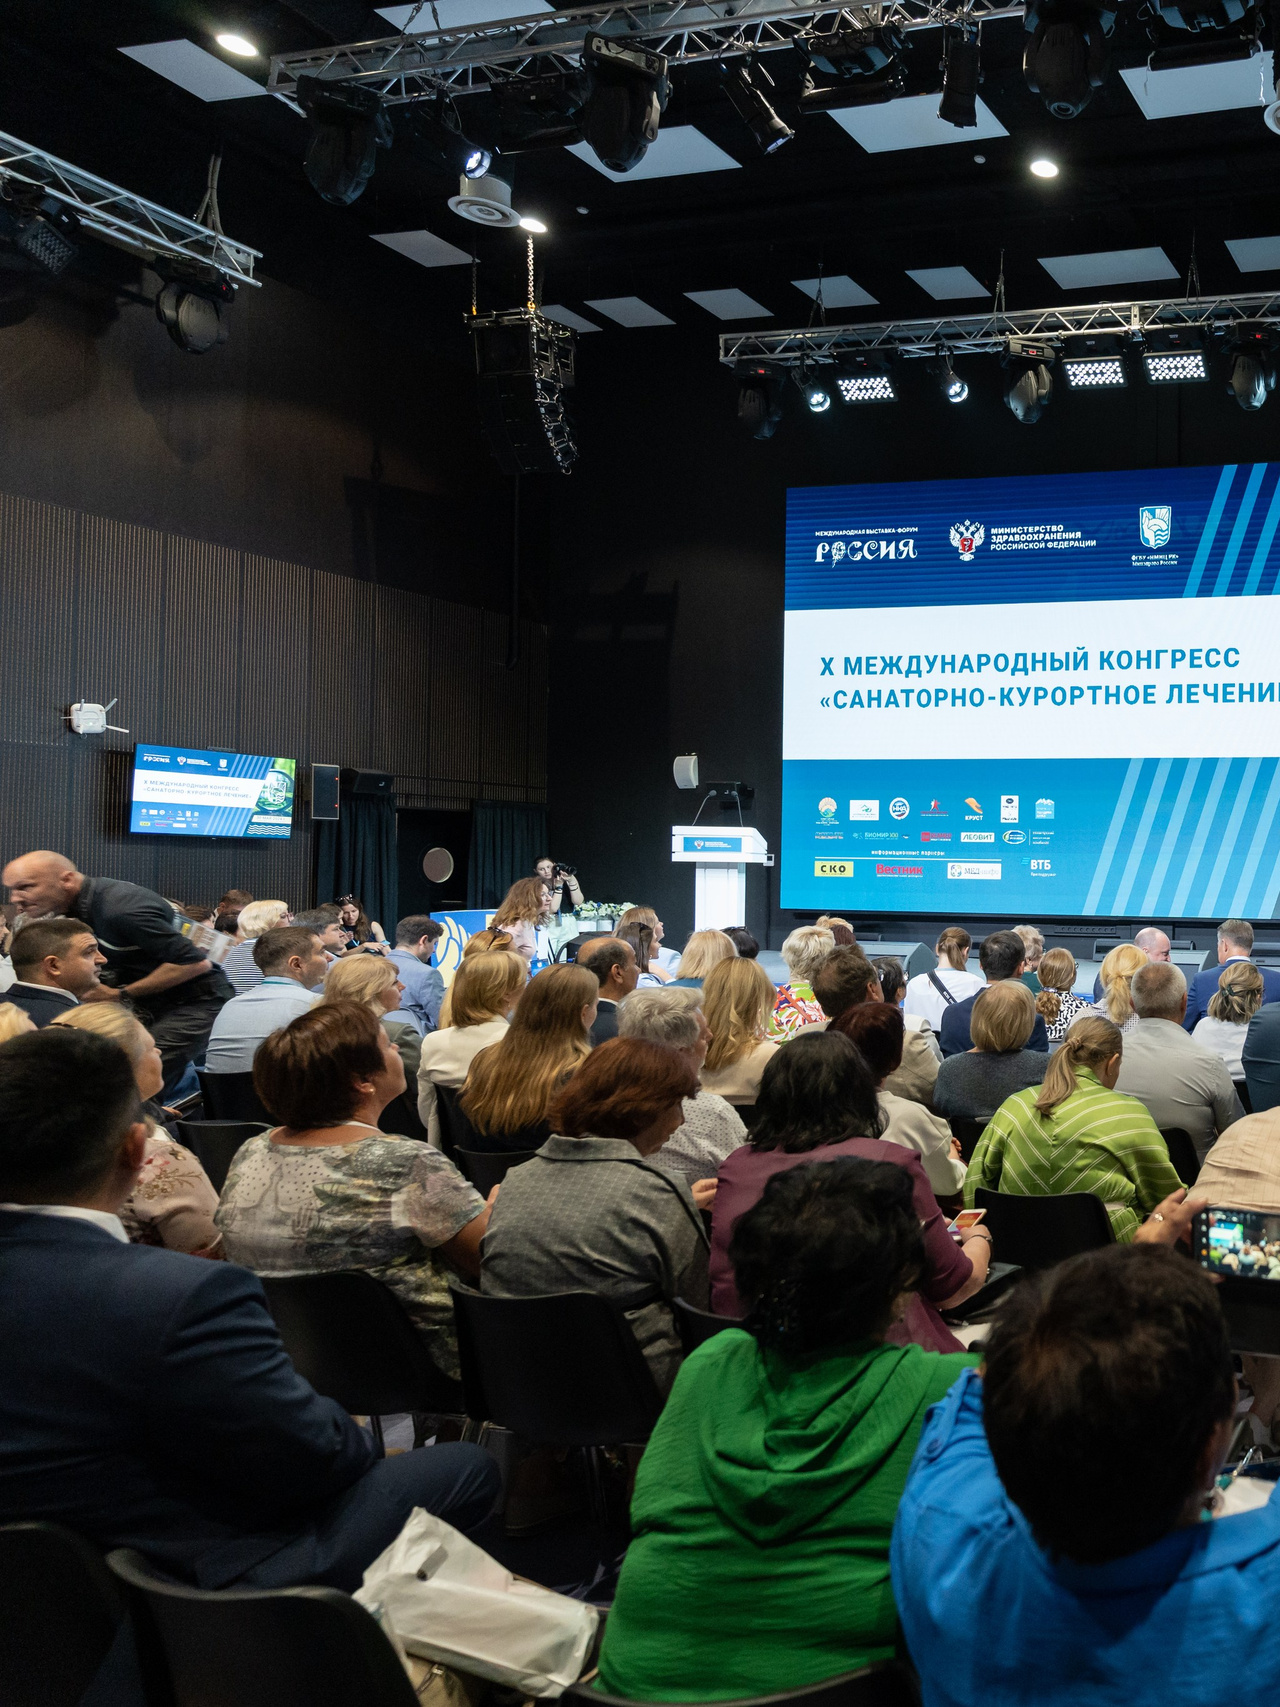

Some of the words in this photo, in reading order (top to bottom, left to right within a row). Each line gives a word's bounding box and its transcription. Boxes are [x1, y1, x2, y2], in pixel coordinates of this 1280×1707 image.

[815, 529, 865, 537] МЕЖДУНАРОДНАЯ
[866, 527, 918, 535] ВЫСТАВКА-ФОРУМ
[991, 524, 1064, 534] МИНИСТЕРСТВО
[991, 531, 1081, 543] ЗДРАВООХРАНЕНИЯ
[991, 541, 1045, 550] РОССИЙСКОЙ
[1047, 540, 1096, 549] ФЕДЕРАЦИИ
[815, 539, 918, 568] РОССИЯ
[844, 646, 1089, 678] МЕЖДУНАРОДНЫЙ
[1100, 647, 1240, 671] КОНГРЕСС
[820, 684, 1156, 710] «САНАТОРНО-КУРОРТНОЕ
[962, 833, 993, 841] ЛЕОВИТ
[876, 863, 923, 875] Вестник
[1030, 859, 1051, 870] ВТБ
